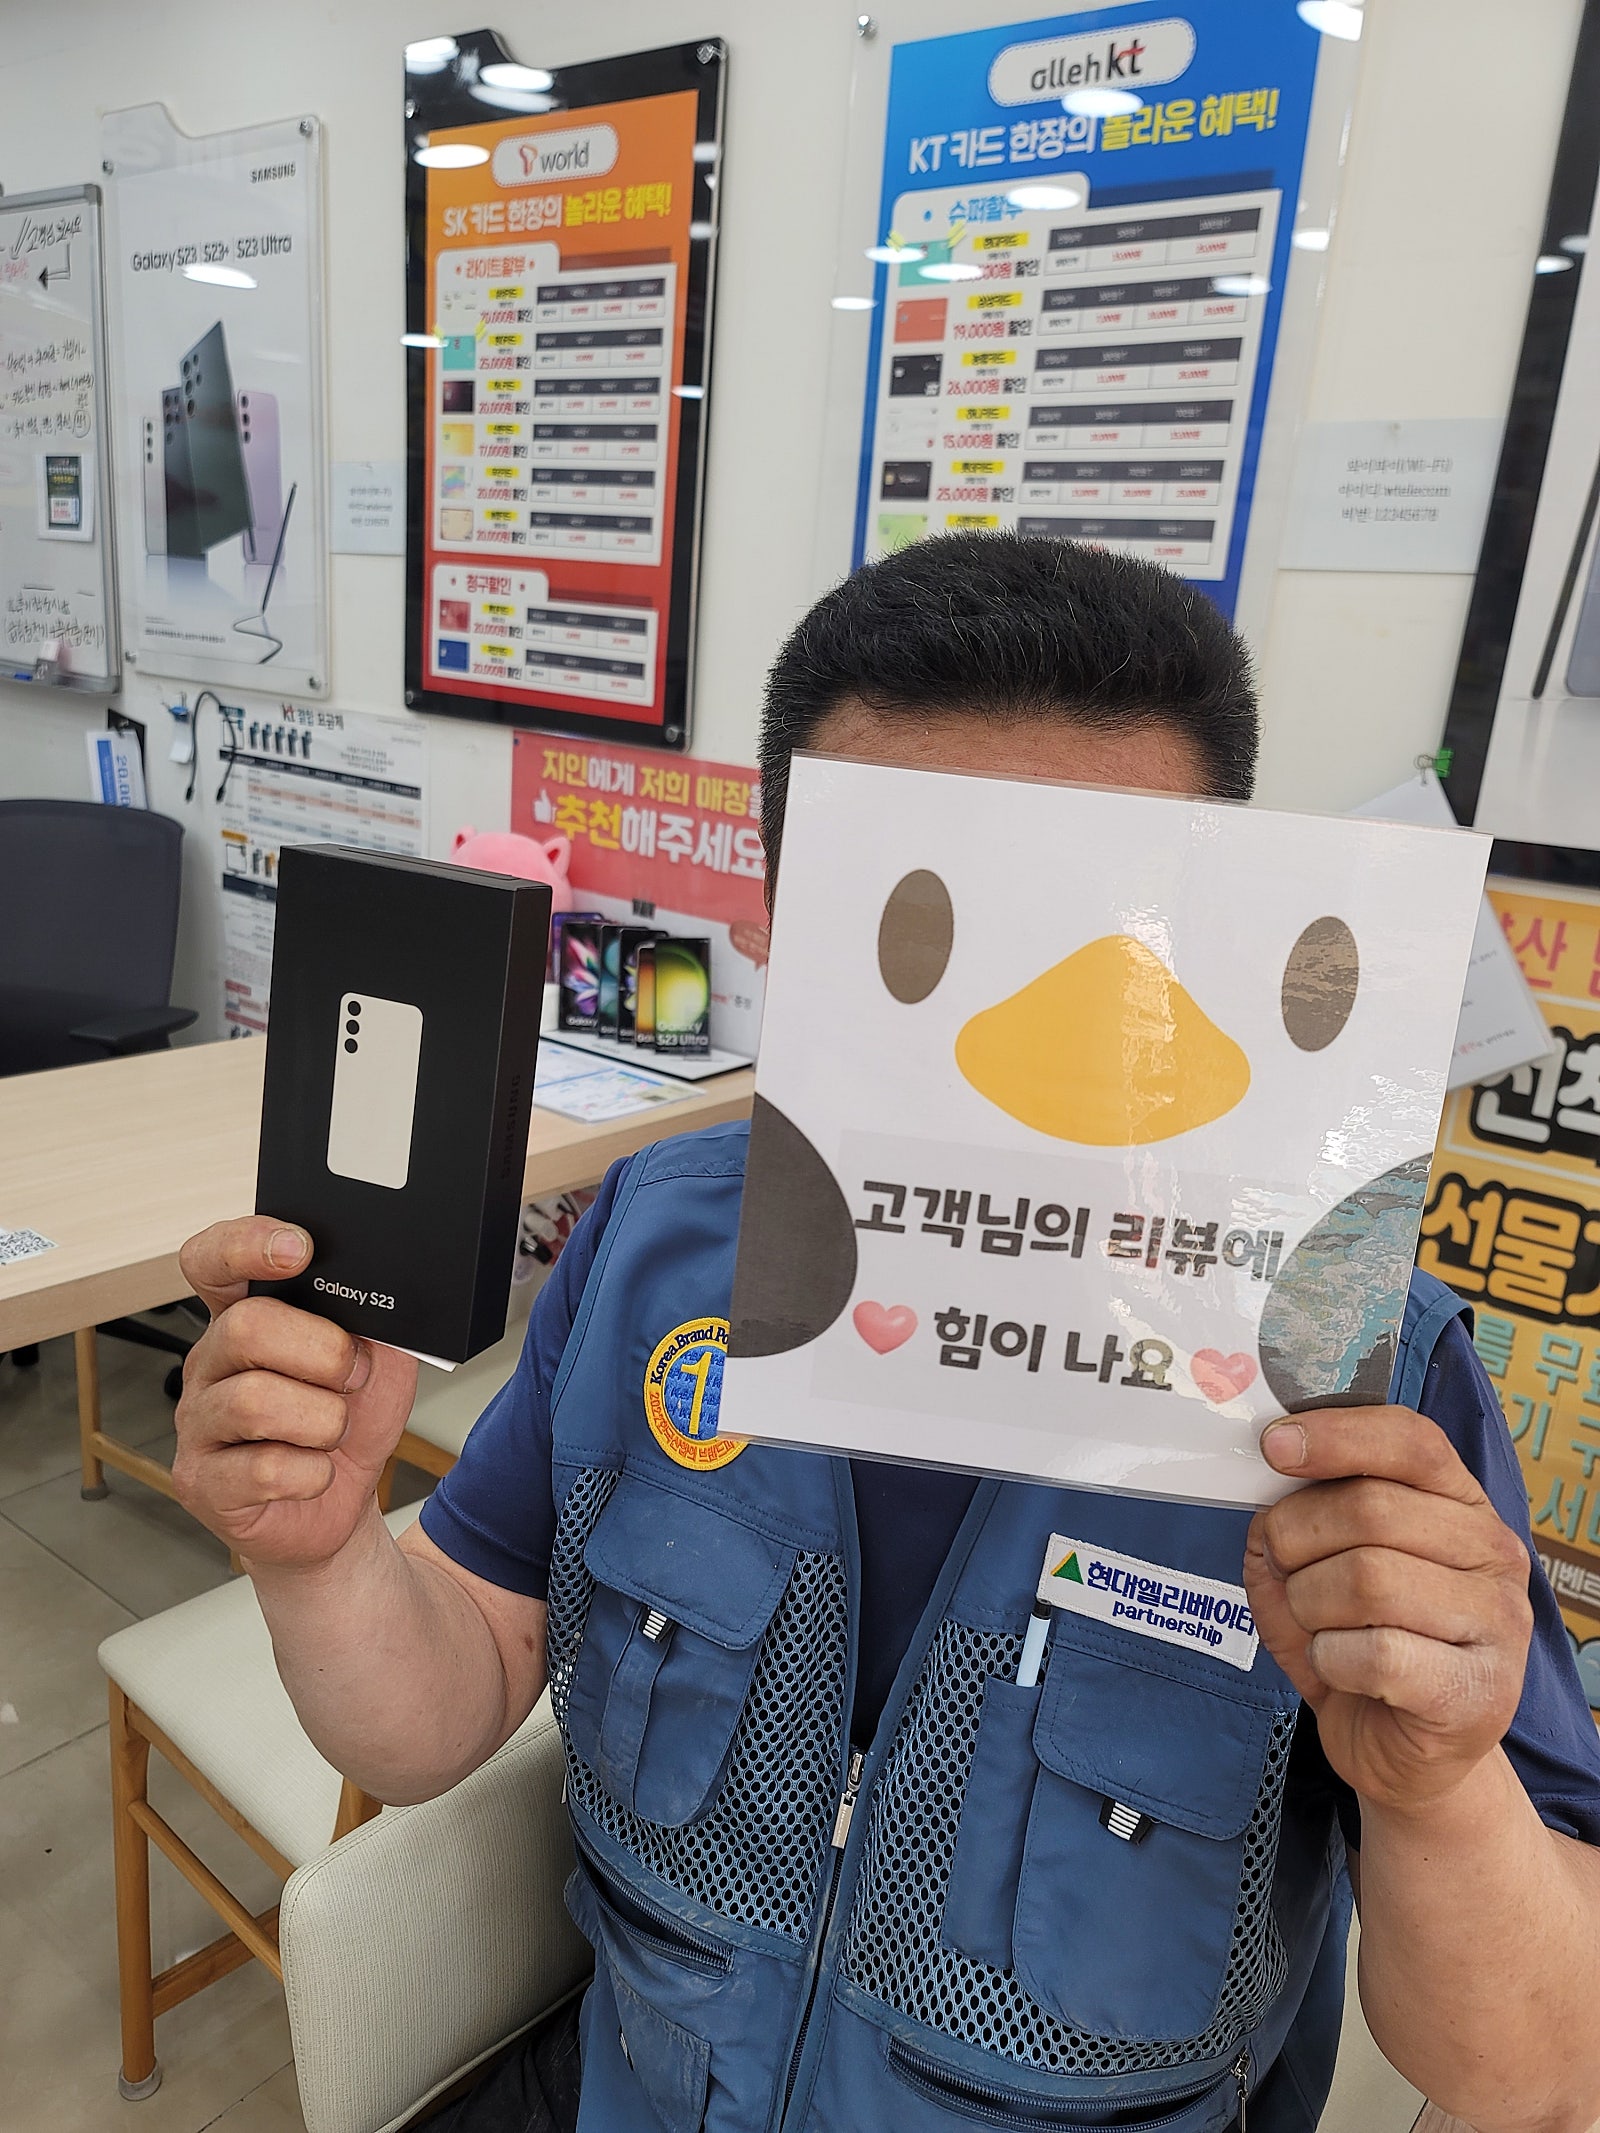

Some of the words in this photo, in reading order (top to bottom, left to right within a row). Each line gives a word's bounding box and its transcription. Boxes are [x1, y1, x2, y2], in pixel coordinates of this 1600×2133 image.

[908, 134, 948, 174] KT
[950, 125, 1006, 169] 카드
[1009, 115, 1097, 164] 한장의
[1100, 99, 1194, 152] 놀라운
[1199, 88, 1281, 139] 혜택!
[250, 162, 296, 183] SAMSUNG
[540, 138, 589, 173] world
[443, 206, 468, 236] SK
[471, 200, 505, 235] 카드
[507, 194, 563, 232] 한장의
[565, 185, 622, 227] 놀라운
[623, 182, 673, 220] 혜택!
[132, 252, 175, 272] Galaxy
[177, 246, 197, 266] S23
[236, 236, 258, 259] S23
[261, 234, 292, 256] Ultra
[1015, 259, 1039, 278] 할인
[1008, 319, 1032, 337] 할인
[1003, 377, 1027, 394] 할인
[996, 432, 1019, 449] 할인
[991, 487, 1014, 503] 할인
[466, 575, 512, 596] 청구할인
[282, 702, 295, 722] kt
[317, 713, 344, 731] 요금제
[541, 749, 635, 797] 지인에게
[640, 767, 690, 807] 저희
[554, 794, 766, 880] 추천해주세요
[566, 1017, 597, 1027] Galaxy
[656, 1022, 702, 1034] Galaxy
[657, 1035, 677, 1046] S23
[679, 1035, 709, 1046] Ultra
[854, 1180, 1091, 1259] 고객님의
[1106, 1212, 1285, 1283] 리뷰에
[313, 1277, 368, 1306] Galaxy
[369, 1291, 395, 1311] S23
[650, 1344, 676, 1386] Korea
[674, 1325, 714, 1348] Brand
[933, 1306, 1047, 1373] 힘이
[1064, 1331, 1176, 1390] 나요
[681, 1351, 713, 1435] 1
[1087, 1561, 1256, 1637] 현대엘리베이터
[1112, 1600, 1223, 1647] partnership
